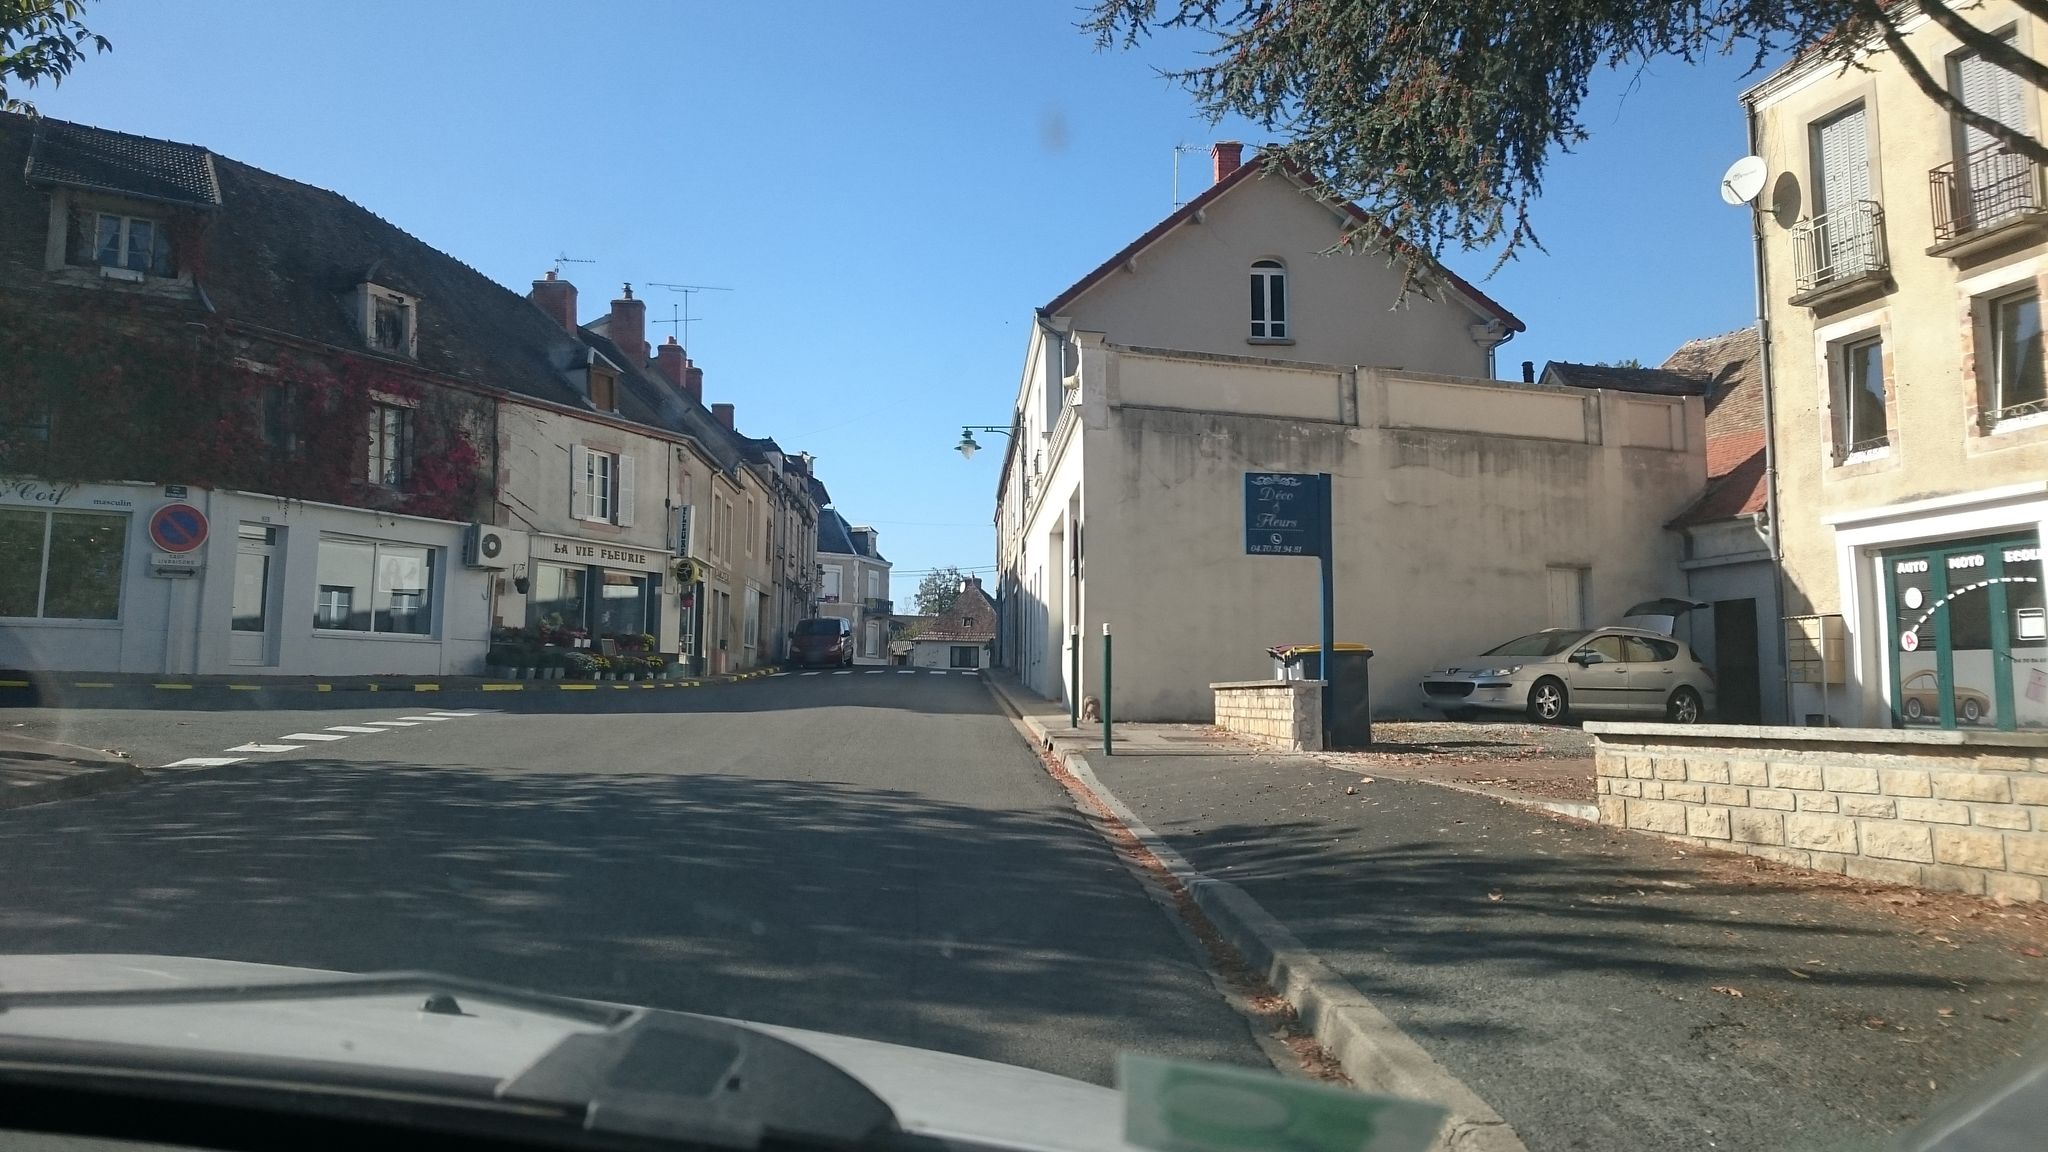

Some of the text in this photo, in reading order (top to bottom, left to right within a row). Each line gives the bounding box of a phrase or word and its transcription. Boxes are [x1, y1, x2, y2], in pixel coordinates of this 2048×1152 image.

[1257, 486, 1294, 501] Déco
[93, 498, 132, 507] masculin
[1256, 513, 1297, 528] Fleurs
[554, 543, 646, 564] LA VIE FLEURIE
[1897, 560, 1928, 574] AUTO
[1948, 554, 1985, 569] MOTO
